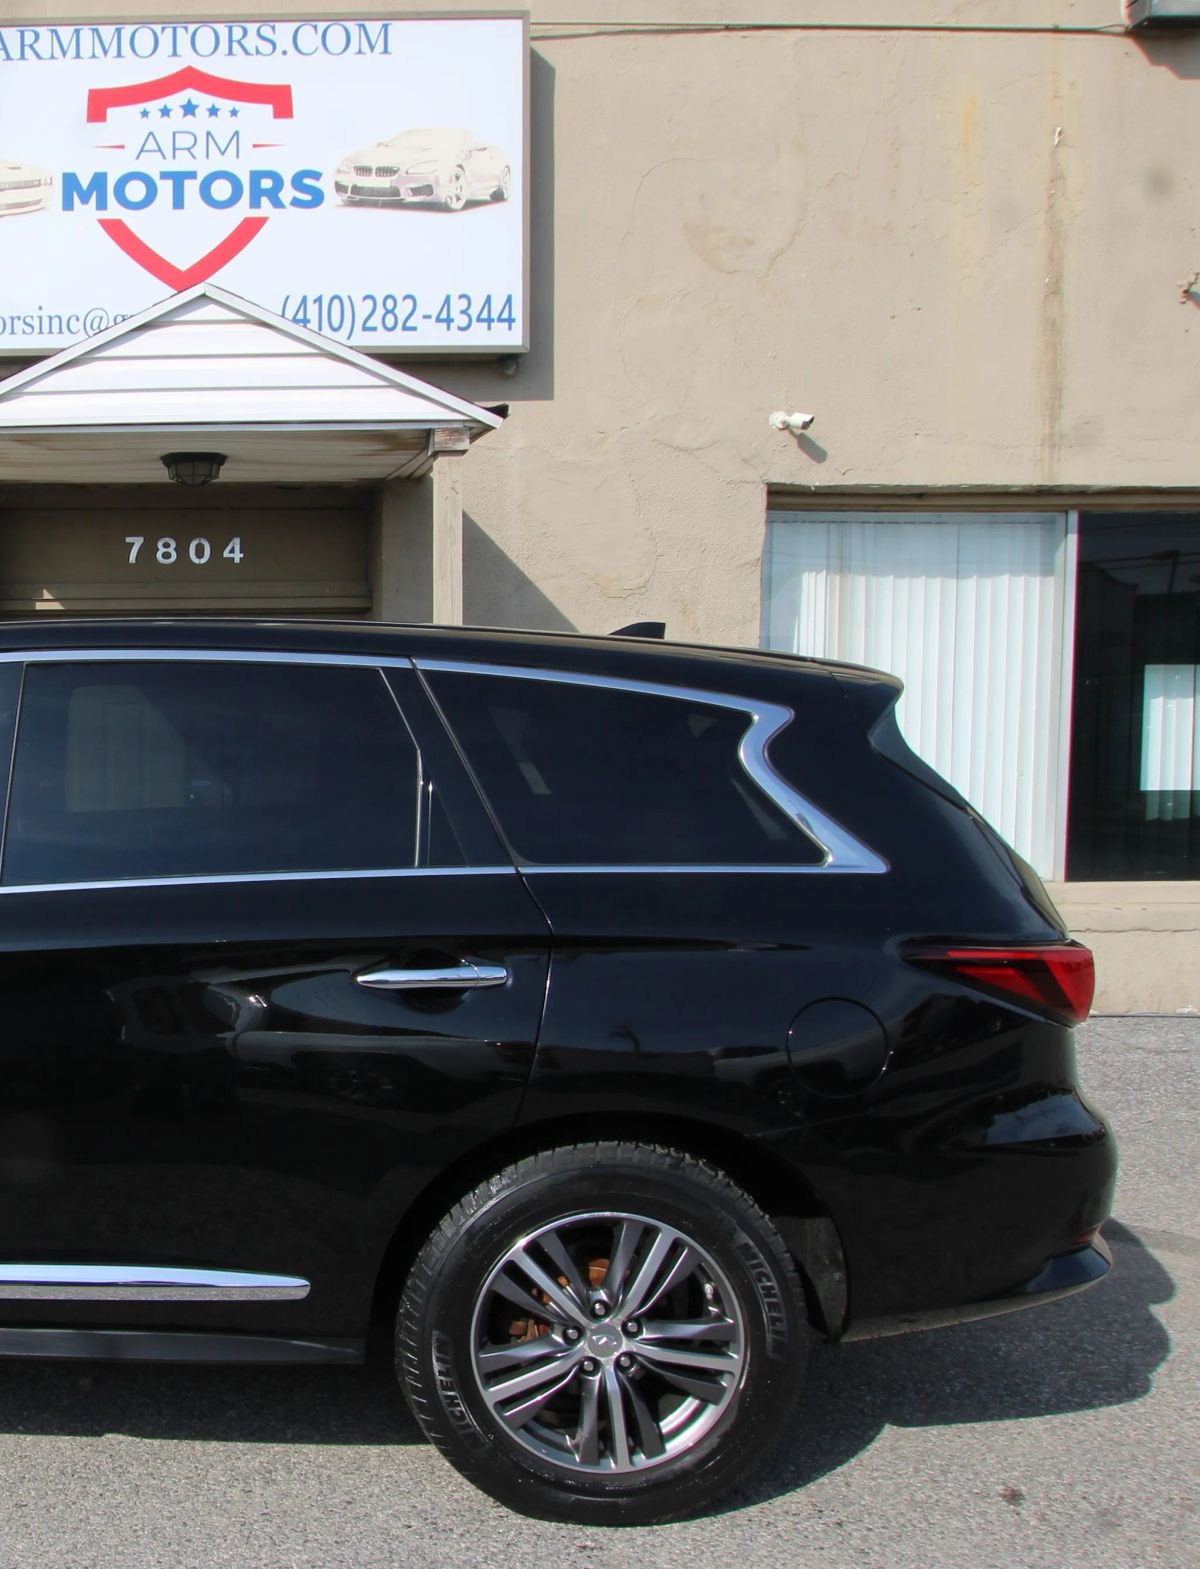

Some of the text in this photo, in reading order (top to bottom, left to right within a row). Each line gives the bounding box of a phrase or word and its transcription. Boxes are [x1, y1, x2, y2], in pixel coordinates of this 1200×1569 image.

[135, 130, 240, 160] ARM
[61, 169, 325, 212] MOTORS
[125, 536, 244, 565] 7804
